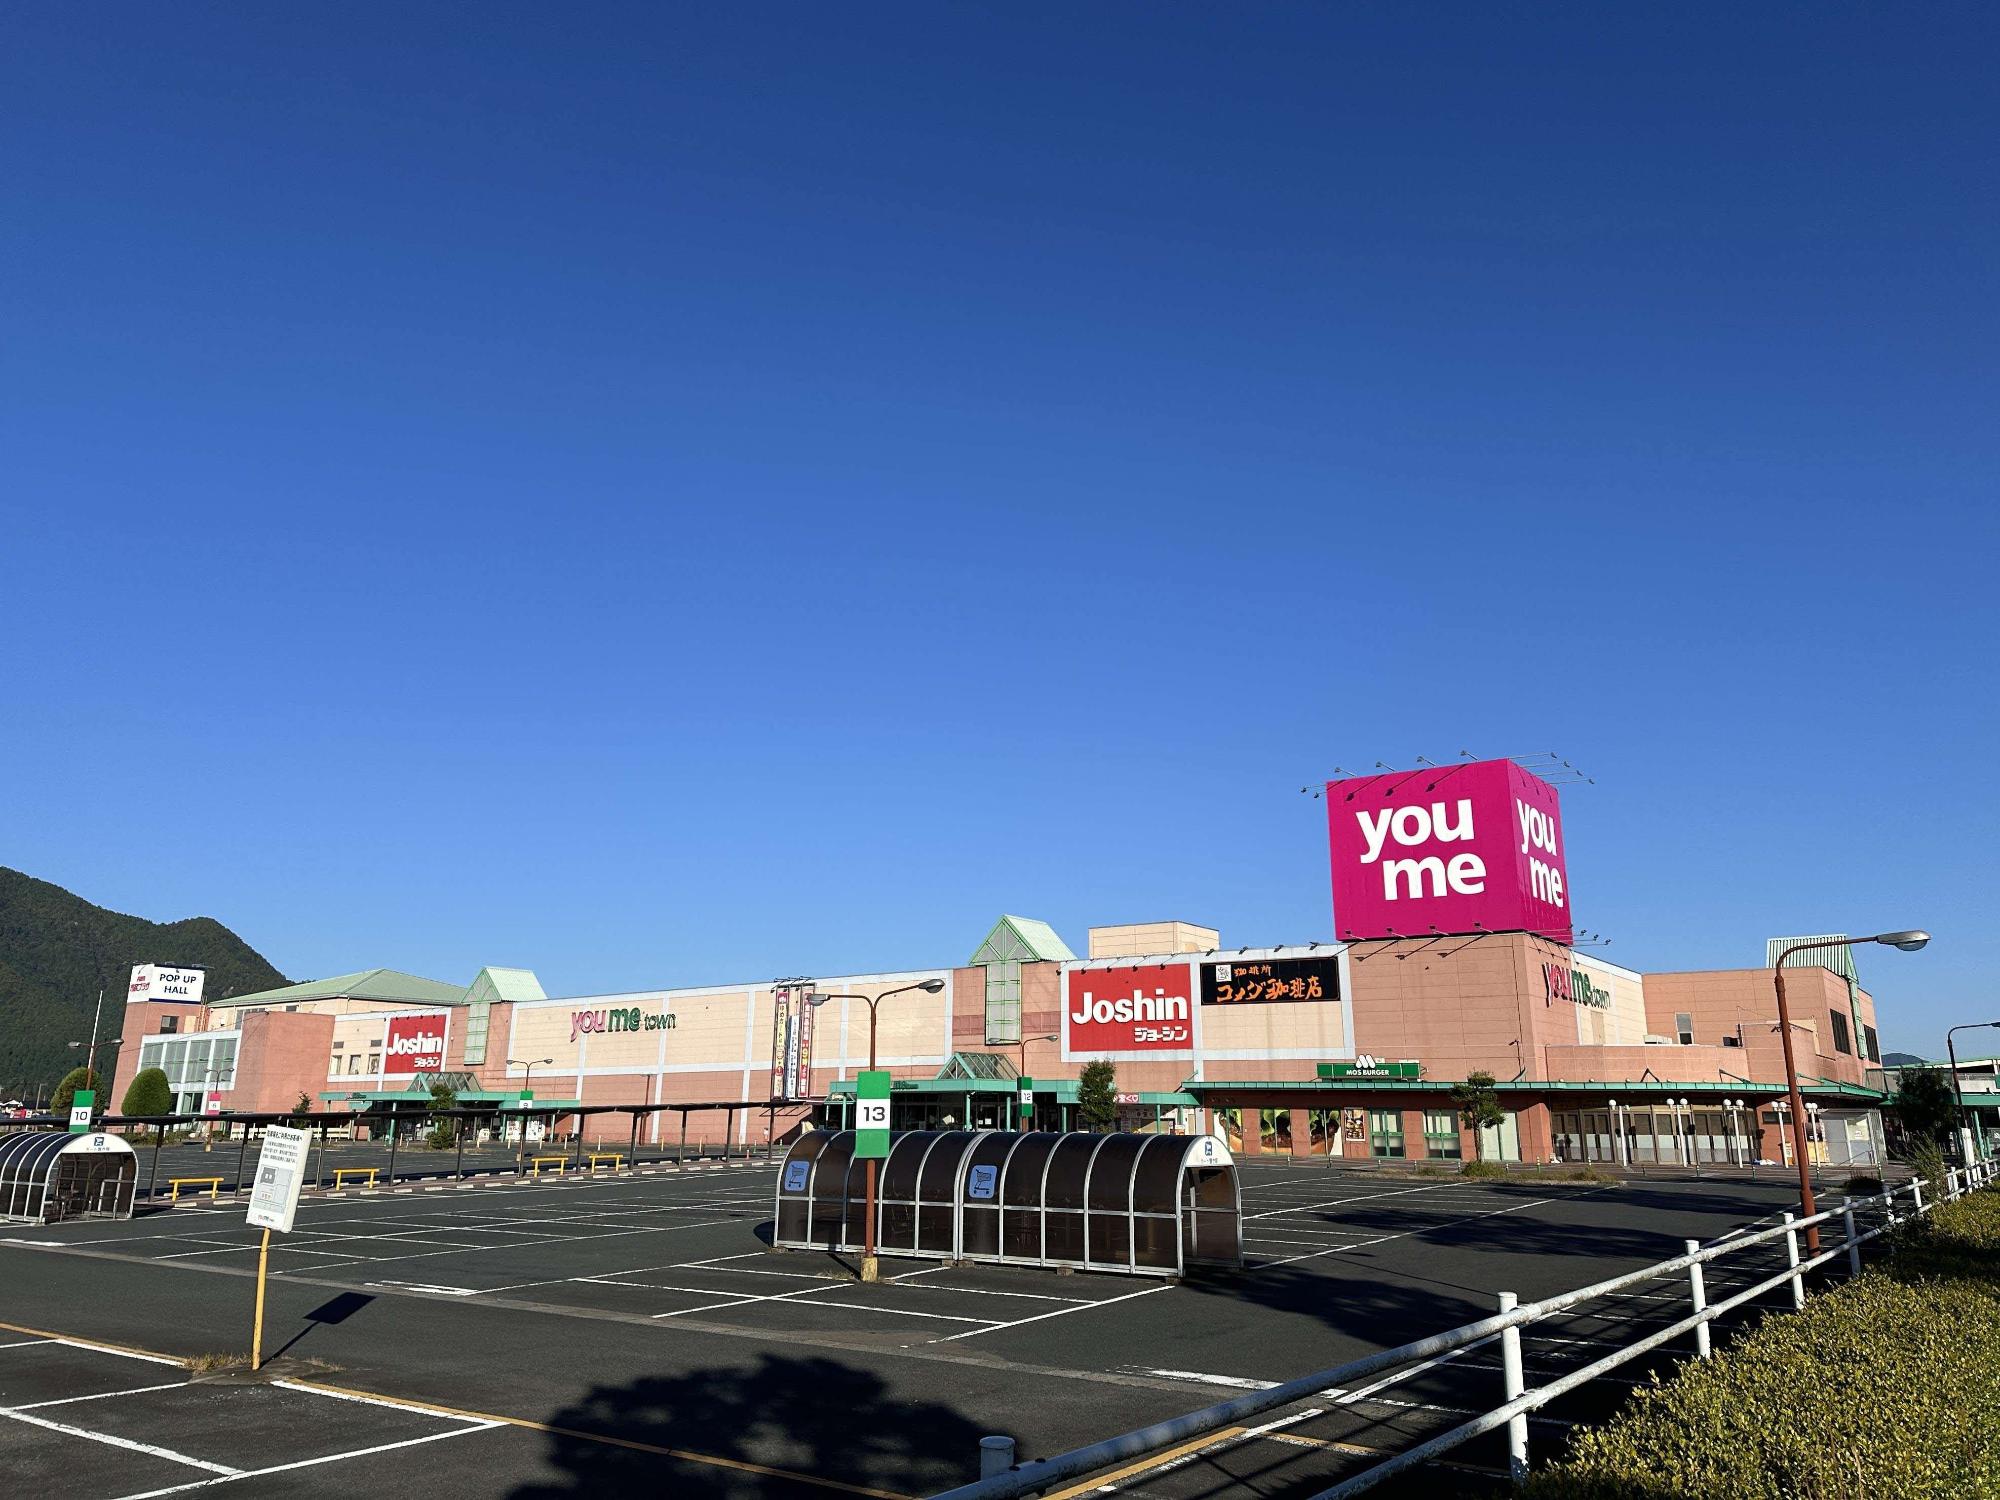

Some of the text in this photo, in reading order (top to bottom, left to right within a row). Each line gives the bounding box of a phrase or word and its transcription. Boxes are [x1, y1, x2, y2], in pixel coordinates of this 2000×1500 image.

[1356, 799, 1475, 864] you
[1516, 798, 1557, 856] you
[1383, 853, 1487, 901] me
[1529, 856, 1564, 908] me
[160, 973, 197, 984] POP UP
[1233, 965, 1272, 977] 珈琲所
[164, 985, 189, 995] HALL
[1217, 975, 1322, 1002] コメダ珈琲店
[1072, 988, 1188, 1025] Joshin
[644, 1013, 677, 1032] town
[387, 1031, 443, 1056] Joshin
[1134, 1026, 1188, 1043] ジョーシン
[1023, 1092, 1032, 1101] 12
[75, 1111, 88, 1121] 10
[863, 1106, 885, 1122] 13
